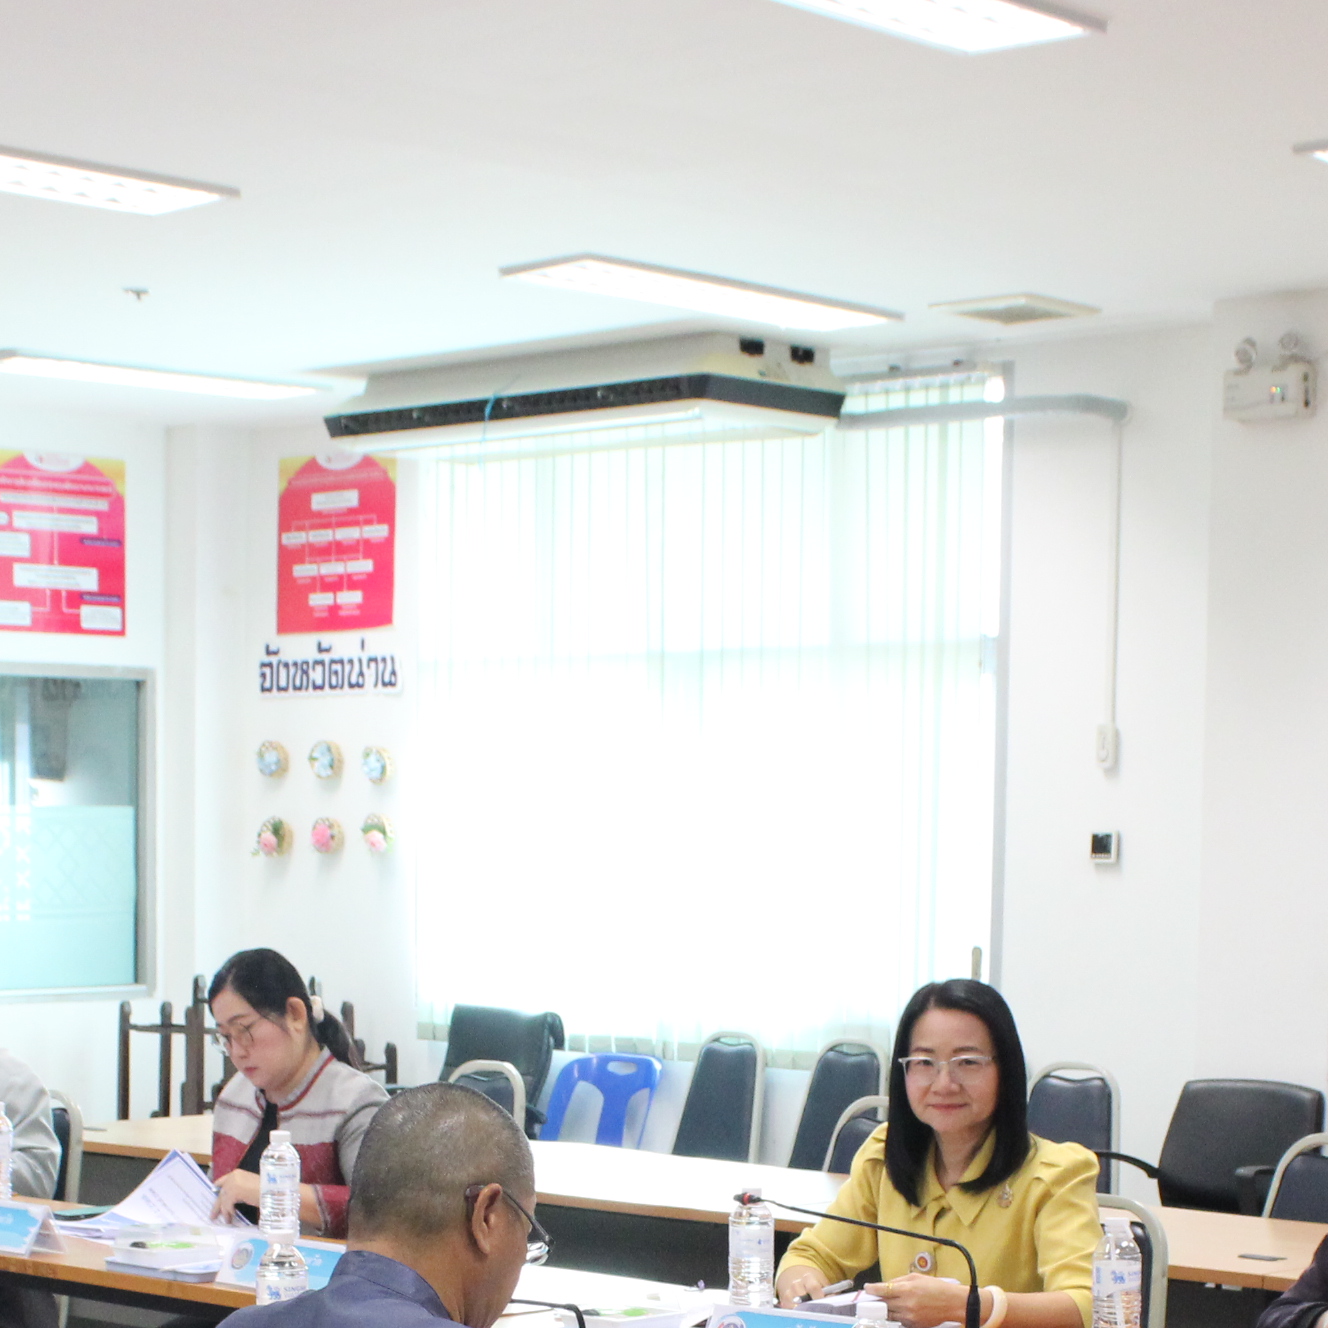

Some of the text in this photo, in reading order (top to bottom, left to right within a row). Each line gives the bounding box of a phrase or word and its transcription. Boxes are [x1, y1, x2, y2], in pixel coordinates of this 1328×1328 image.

[259, 637, 397, 692] จังหวัดน่าน
